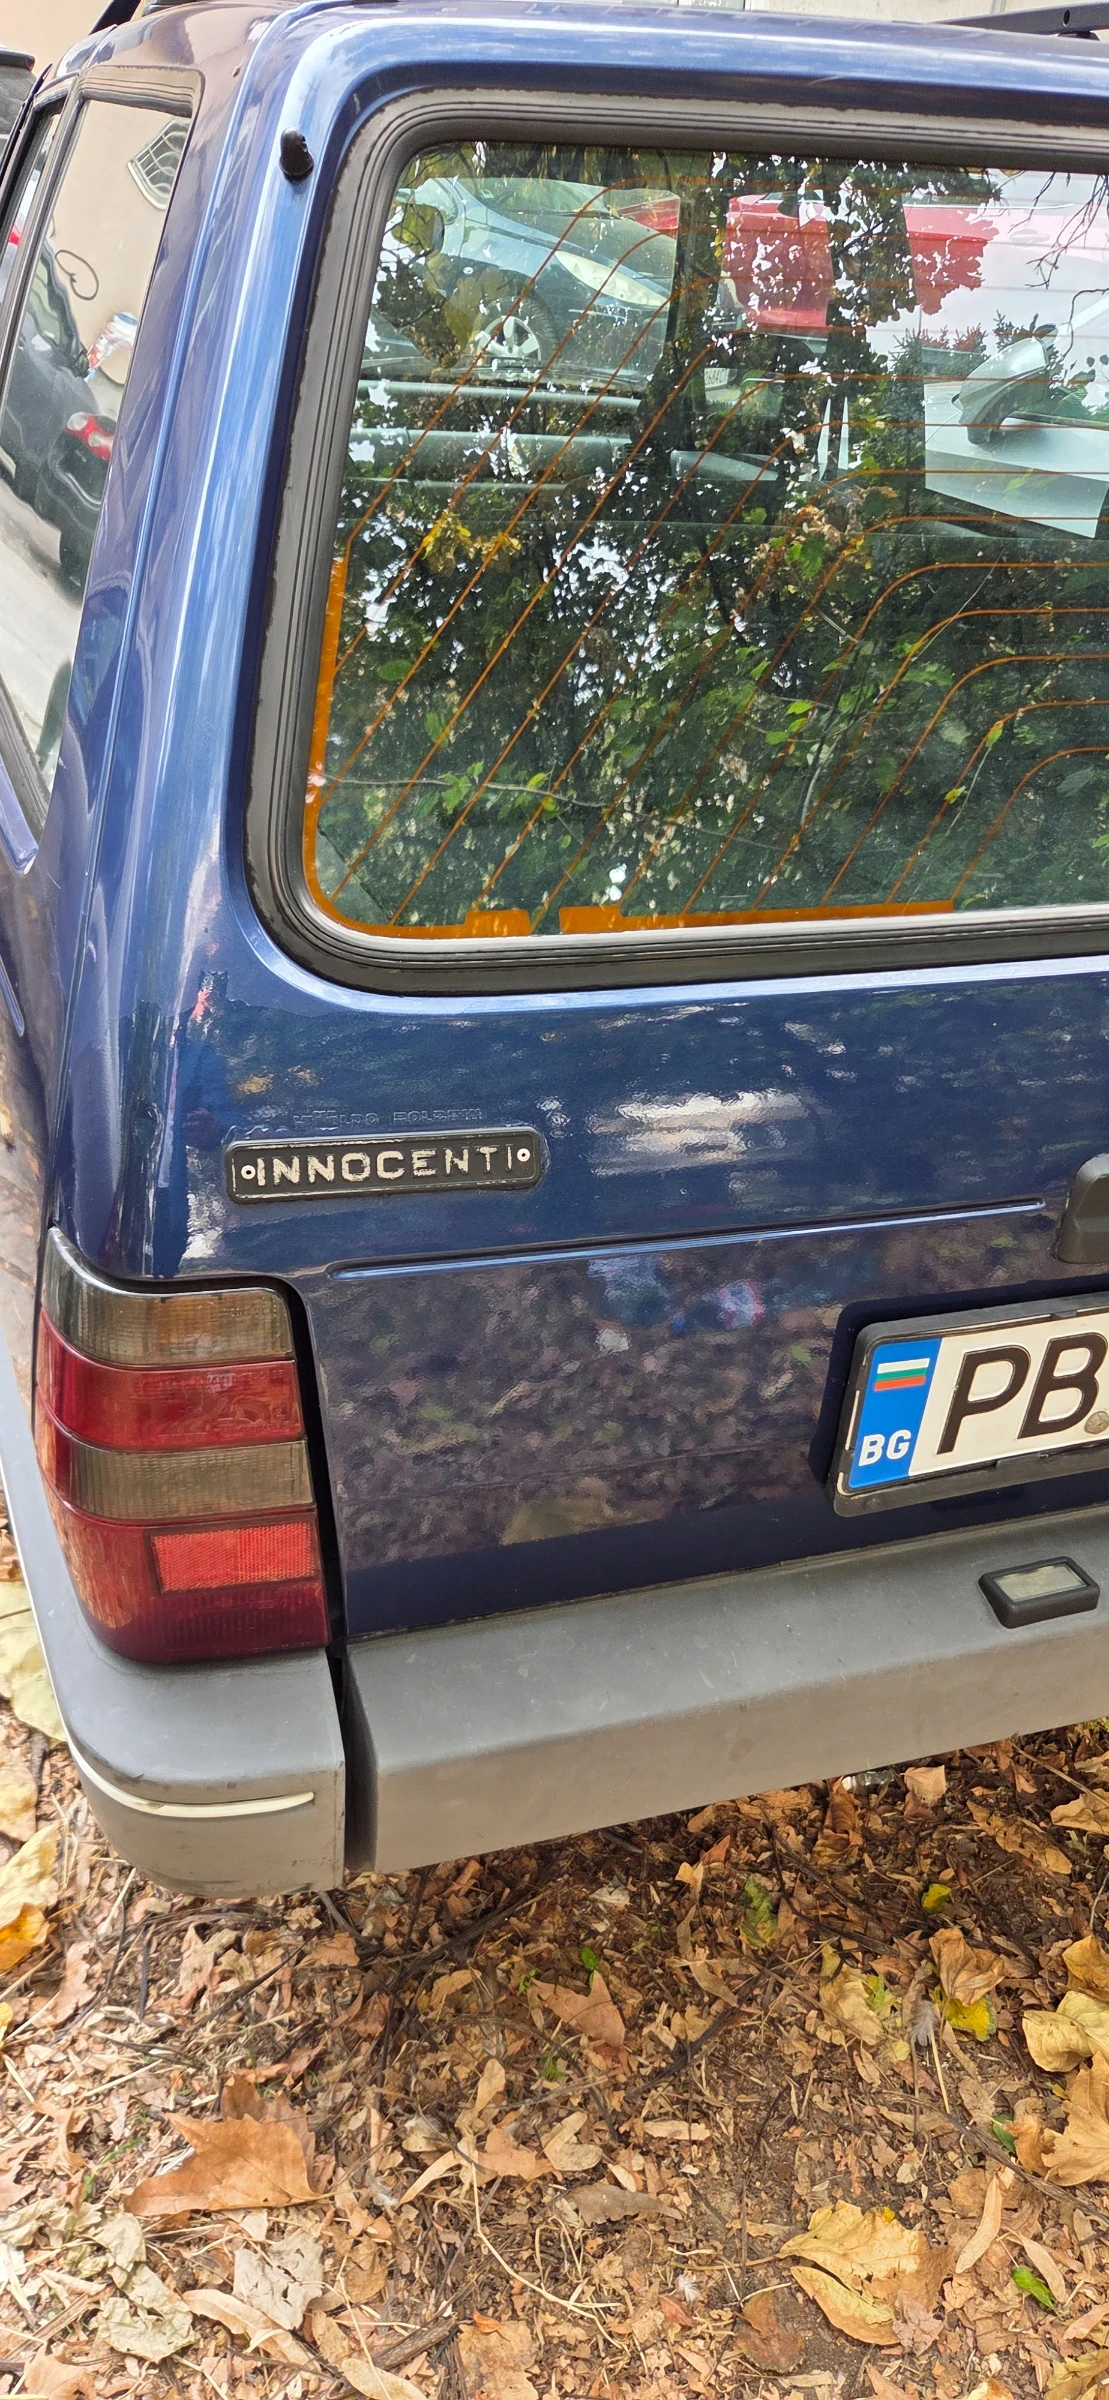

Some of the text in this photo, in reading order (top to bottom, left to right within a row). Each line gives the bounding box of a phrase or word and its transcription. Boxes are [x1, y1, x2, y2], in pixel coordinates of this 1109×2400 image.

[257, 1144, 513, 1186] INNOCENTI
[936, 1331, 1108, 1456] PB
[858, 1429, 912, 1467] BG
